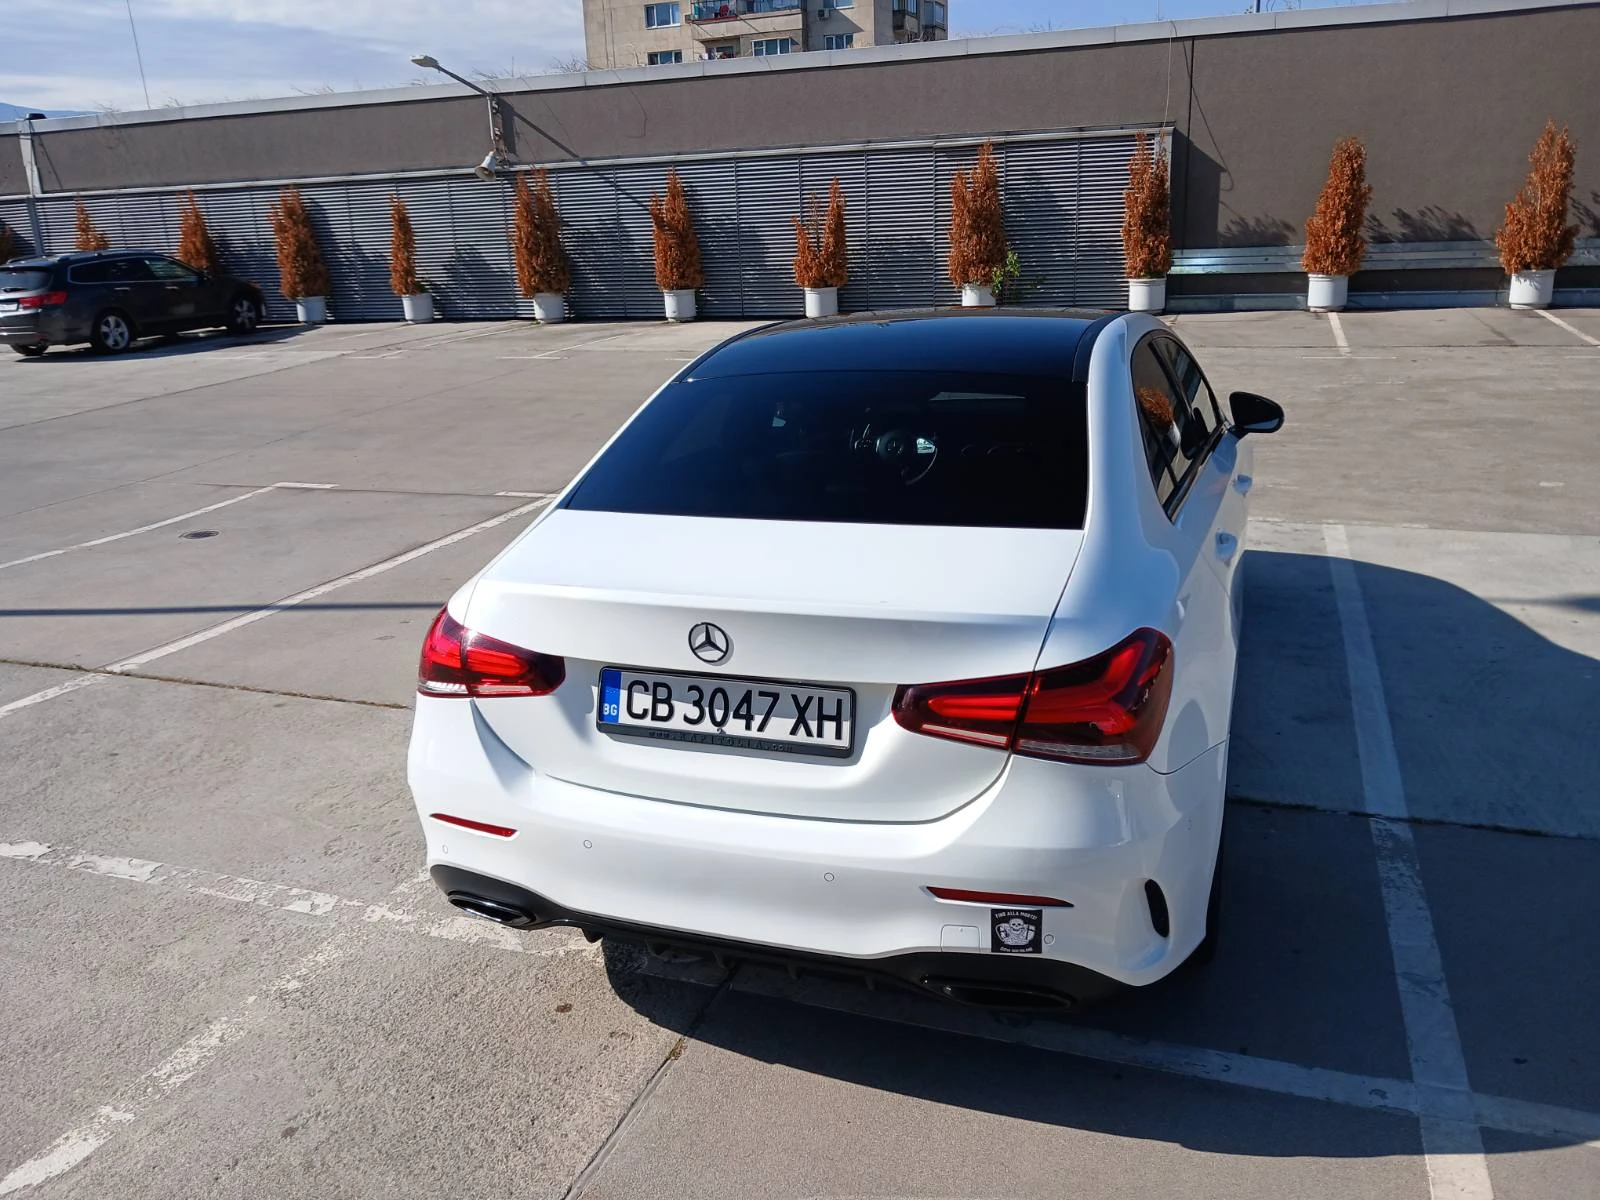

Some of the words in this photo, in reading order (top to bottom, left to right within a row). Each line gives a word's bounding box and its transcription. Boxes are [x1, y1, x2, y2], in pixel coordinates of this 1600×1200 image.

[603, 703, 618, 716] BG
[626, 680, 674, 722] CB
[683, 685, 780, 733] 3047
[789, 693, 843, 740] XH
